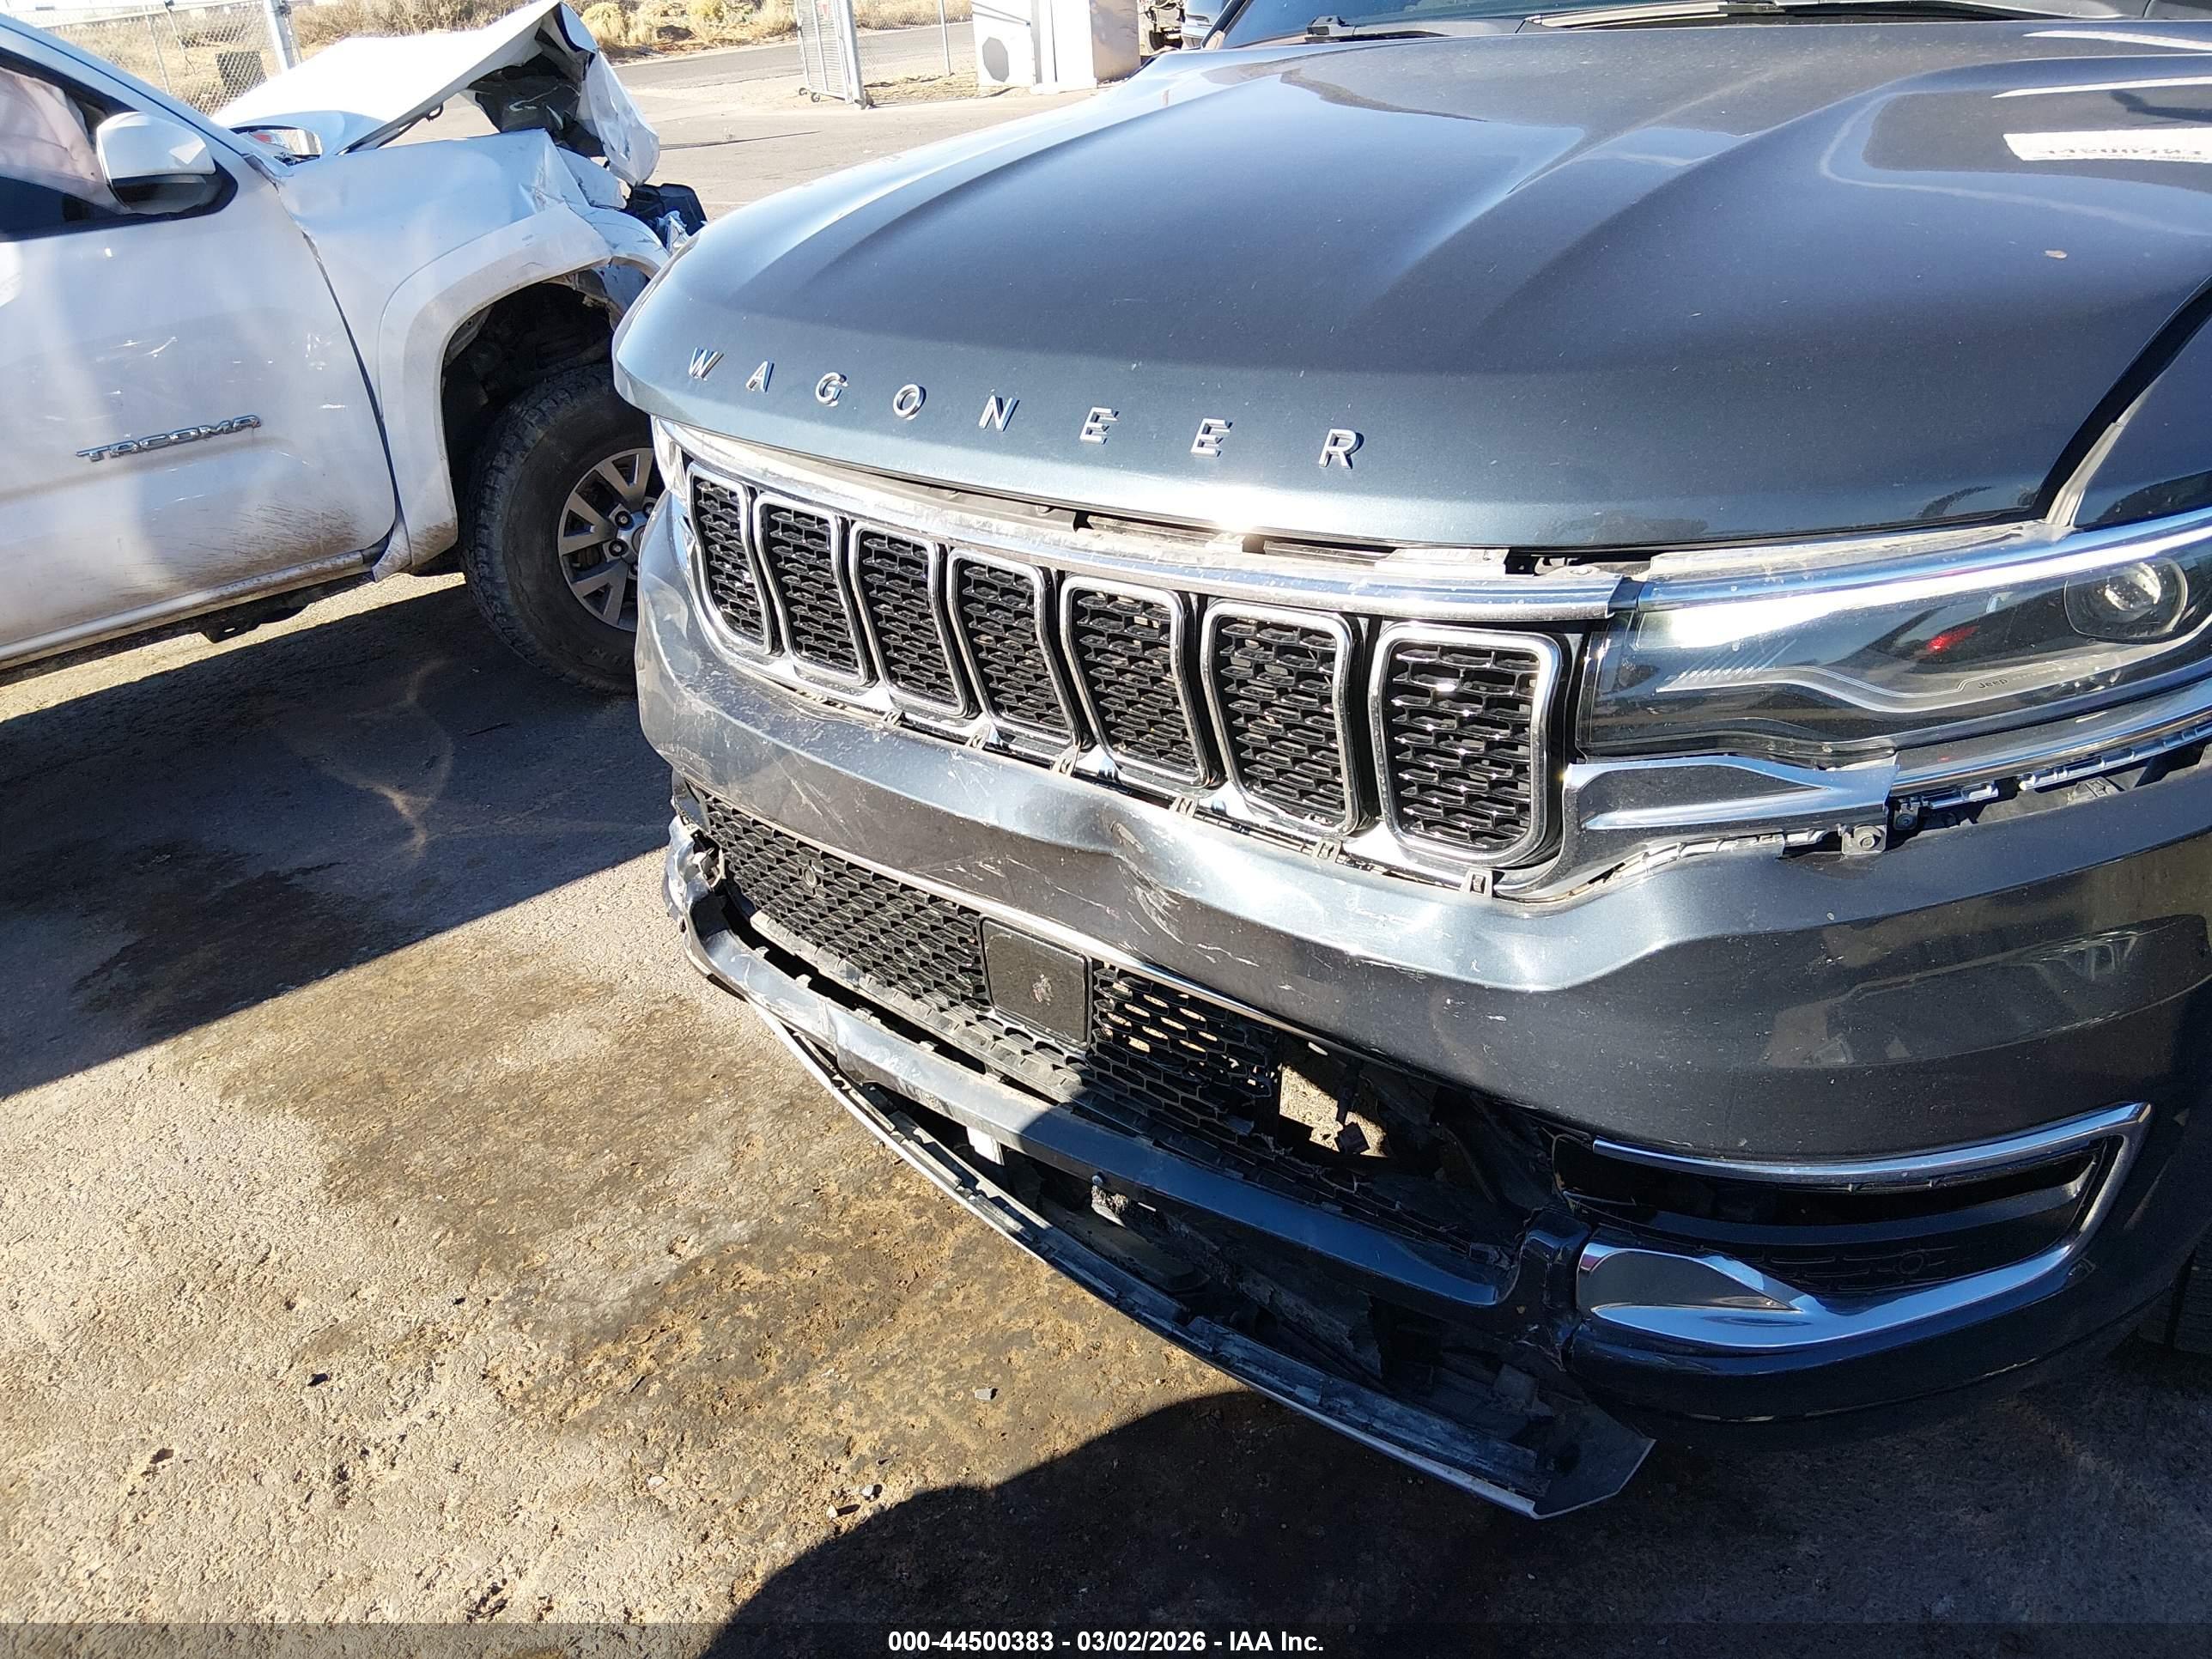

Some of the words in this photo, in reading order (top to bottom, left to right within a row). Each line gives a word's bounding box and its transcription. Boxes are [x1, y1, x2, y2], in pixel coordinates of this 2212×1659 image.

[687, 347, 1364, 469] WAGONEER
[76, 415, 261, 462] TACOMA
[1978, 678, 2008, 689] Jeep
